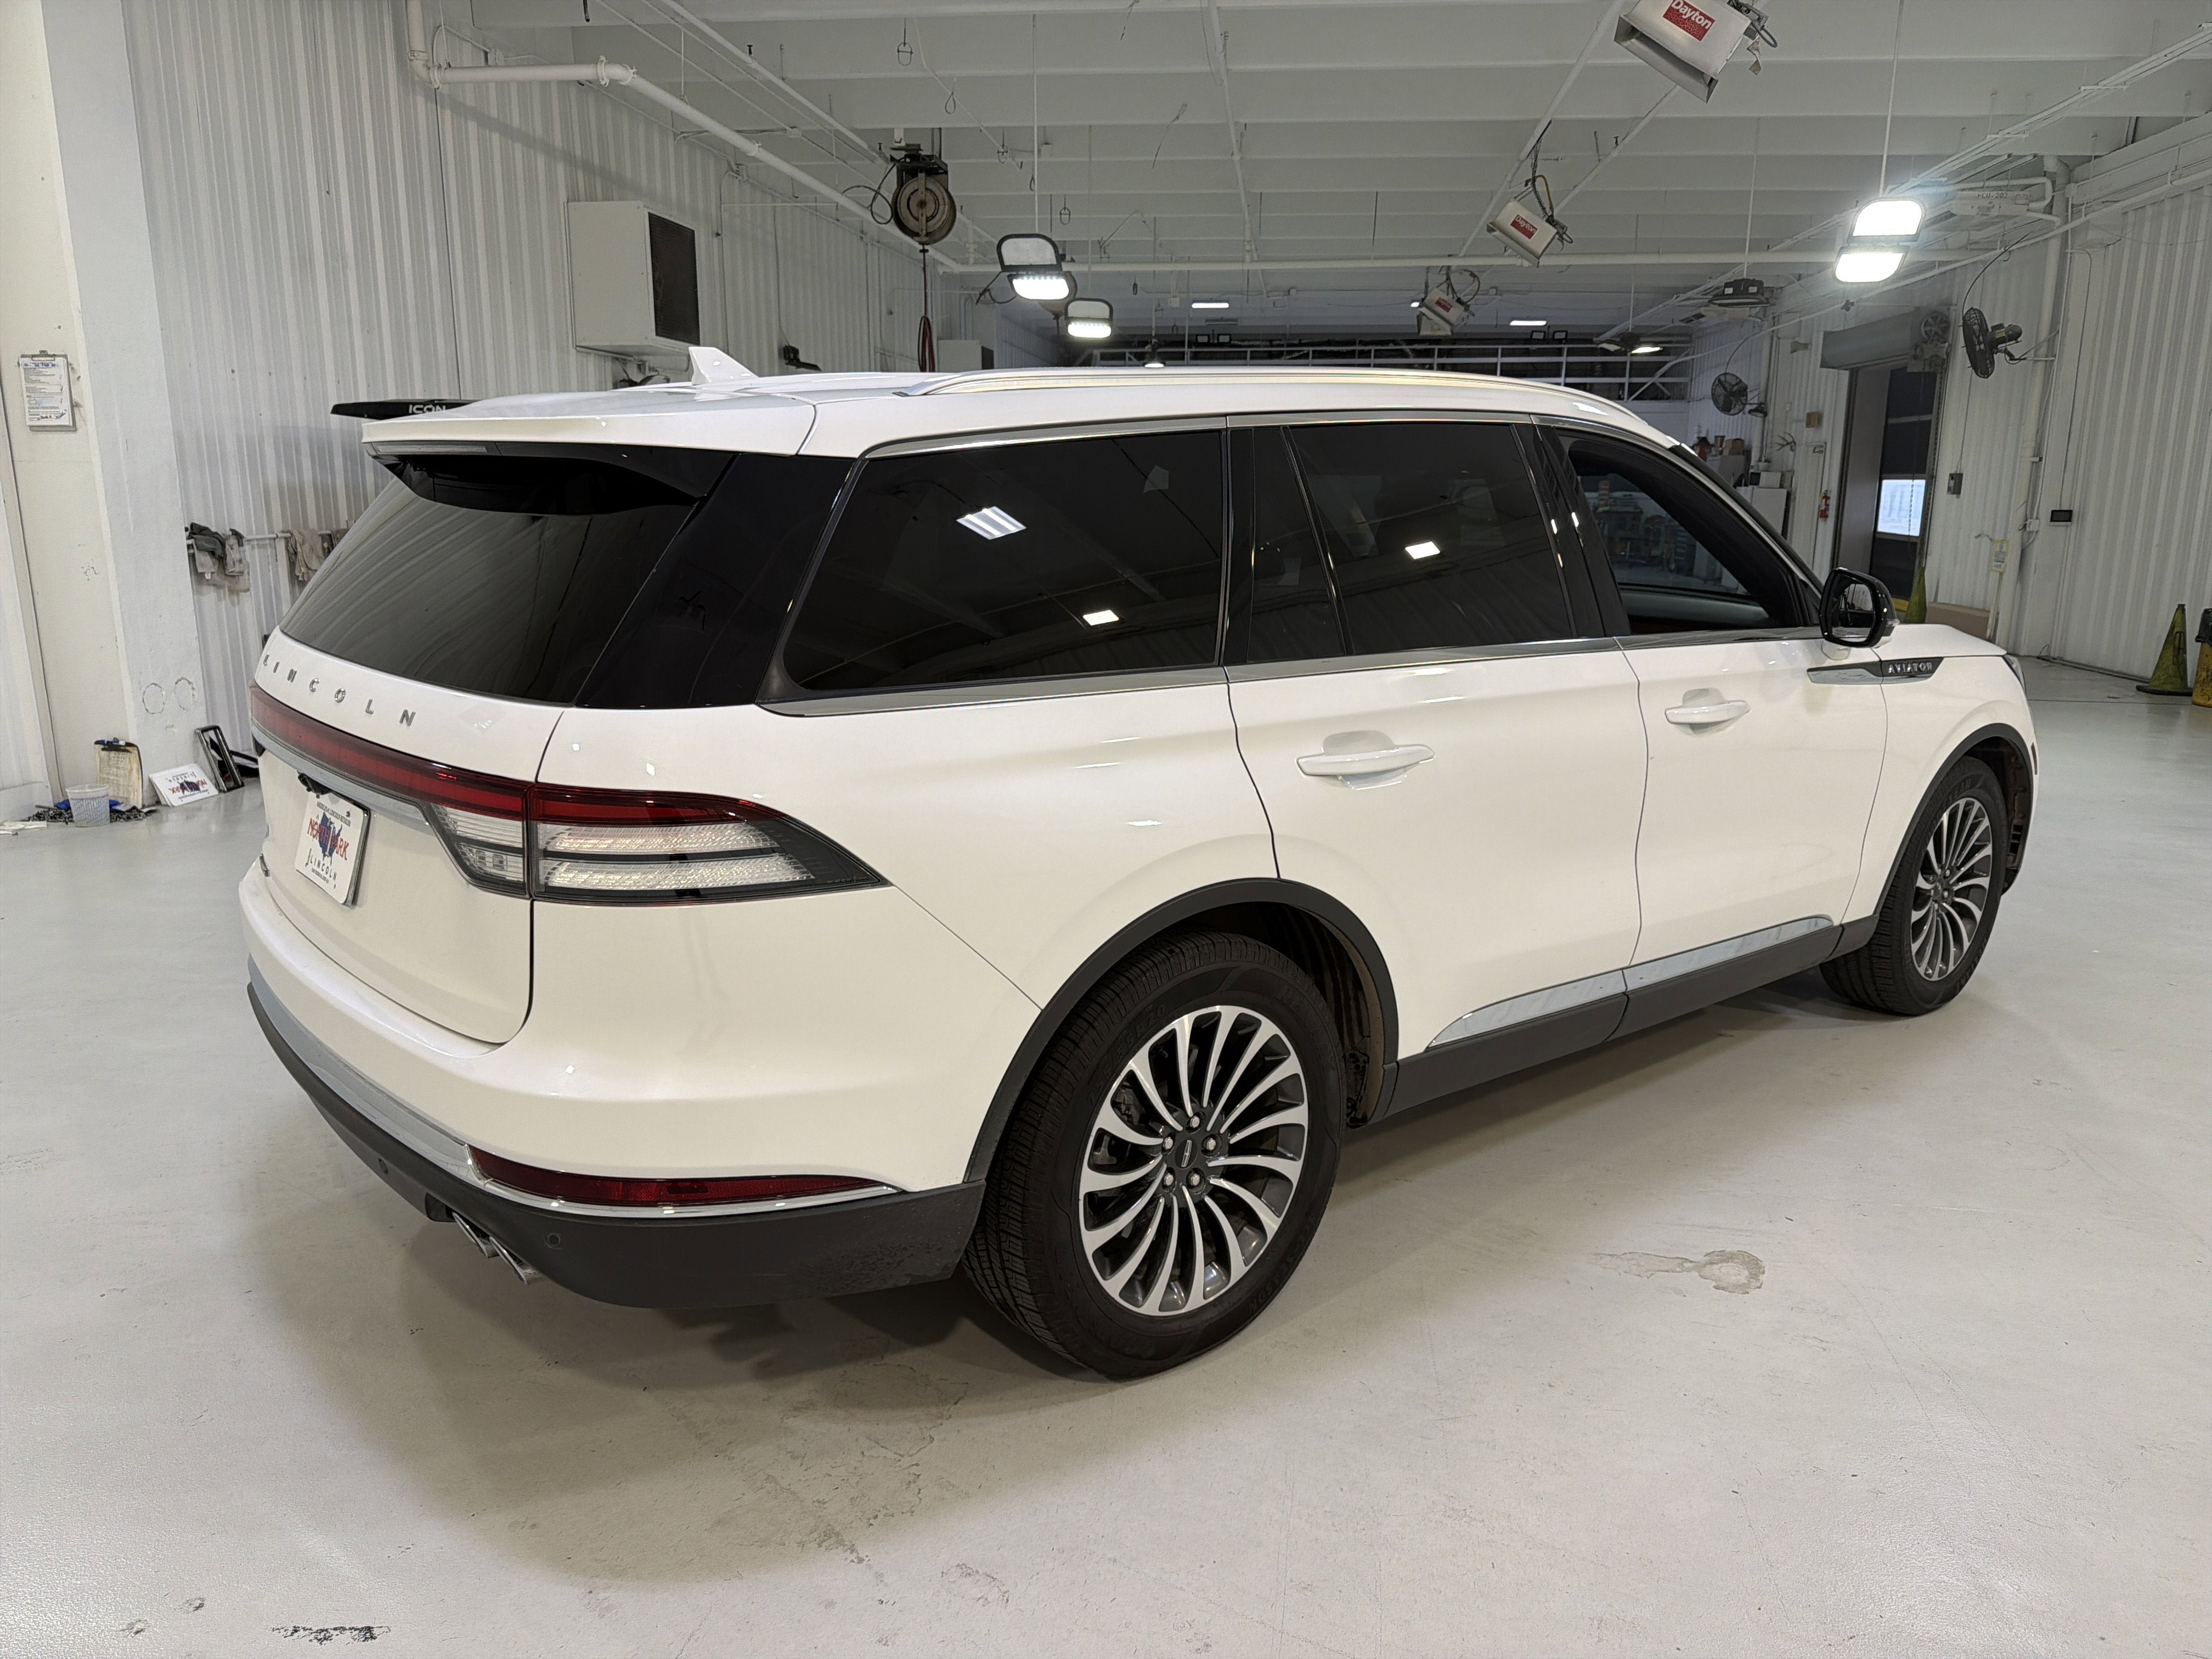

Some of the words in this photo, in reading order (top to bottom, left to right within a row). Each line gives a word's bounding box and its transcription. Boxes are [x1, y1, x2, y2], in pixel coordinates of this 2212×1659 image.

[1671, 0, 1712, 29] Dayton
[1515, 216, 1536, 234] Dayton
[409, 404, 445, 413] ICON
[1888, 662, 1932, 673] AVIATOR
[263, 653, 416, 726] LINCOLN
[331, 833, 350, 861] PARK
[310, 855, 337, 882] LINCOLN
